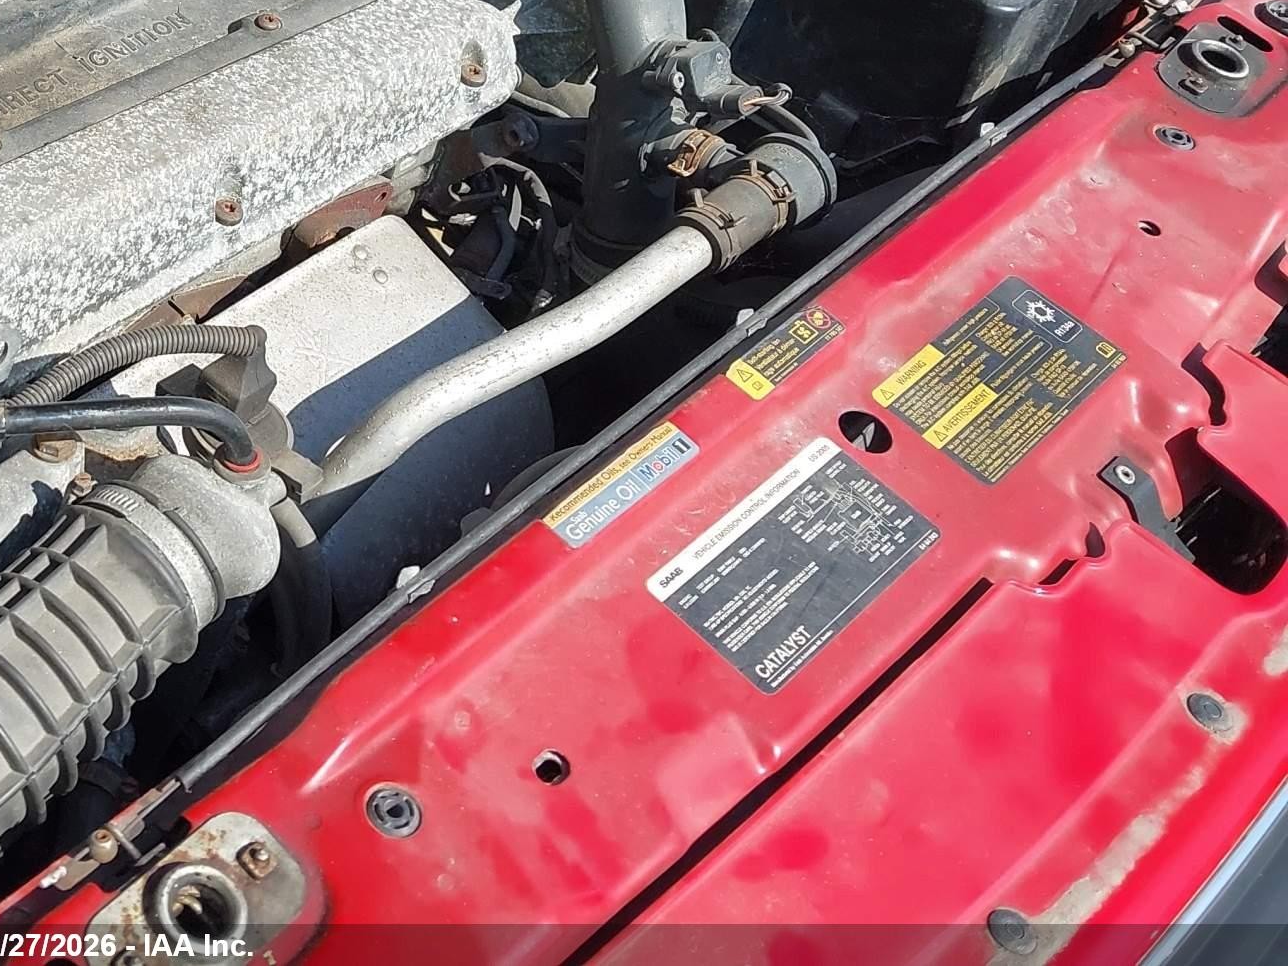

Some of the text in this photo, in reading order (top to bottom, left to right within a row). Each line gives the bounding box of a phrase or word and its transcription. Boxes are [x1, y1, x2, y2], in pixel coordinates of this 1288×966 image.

[72, 10, 194, 74] IGNITION
[1054, 320, 1075, 337] R134a
[896, 359, 926, 385] WARNING
[942, 388, 991, 432] AVERTISSEMENT
[640, 438, 690, 481] Mobil 1
[550, 479, 604, 521] Recommended
[601, 465, 621, 481] Oils,
[566, 478, 641, 539] Genuine Oil
[660, 567, 684, 589] SAAB
[692, 538, 719, 561] VEHICLE
[715, 517, 743, 542] EMISSION
[740, 496, 768, 520] CONTROL
[765, 468, 801, 500] INFORMATION
[754, 625, 813, 679] CATALYST
